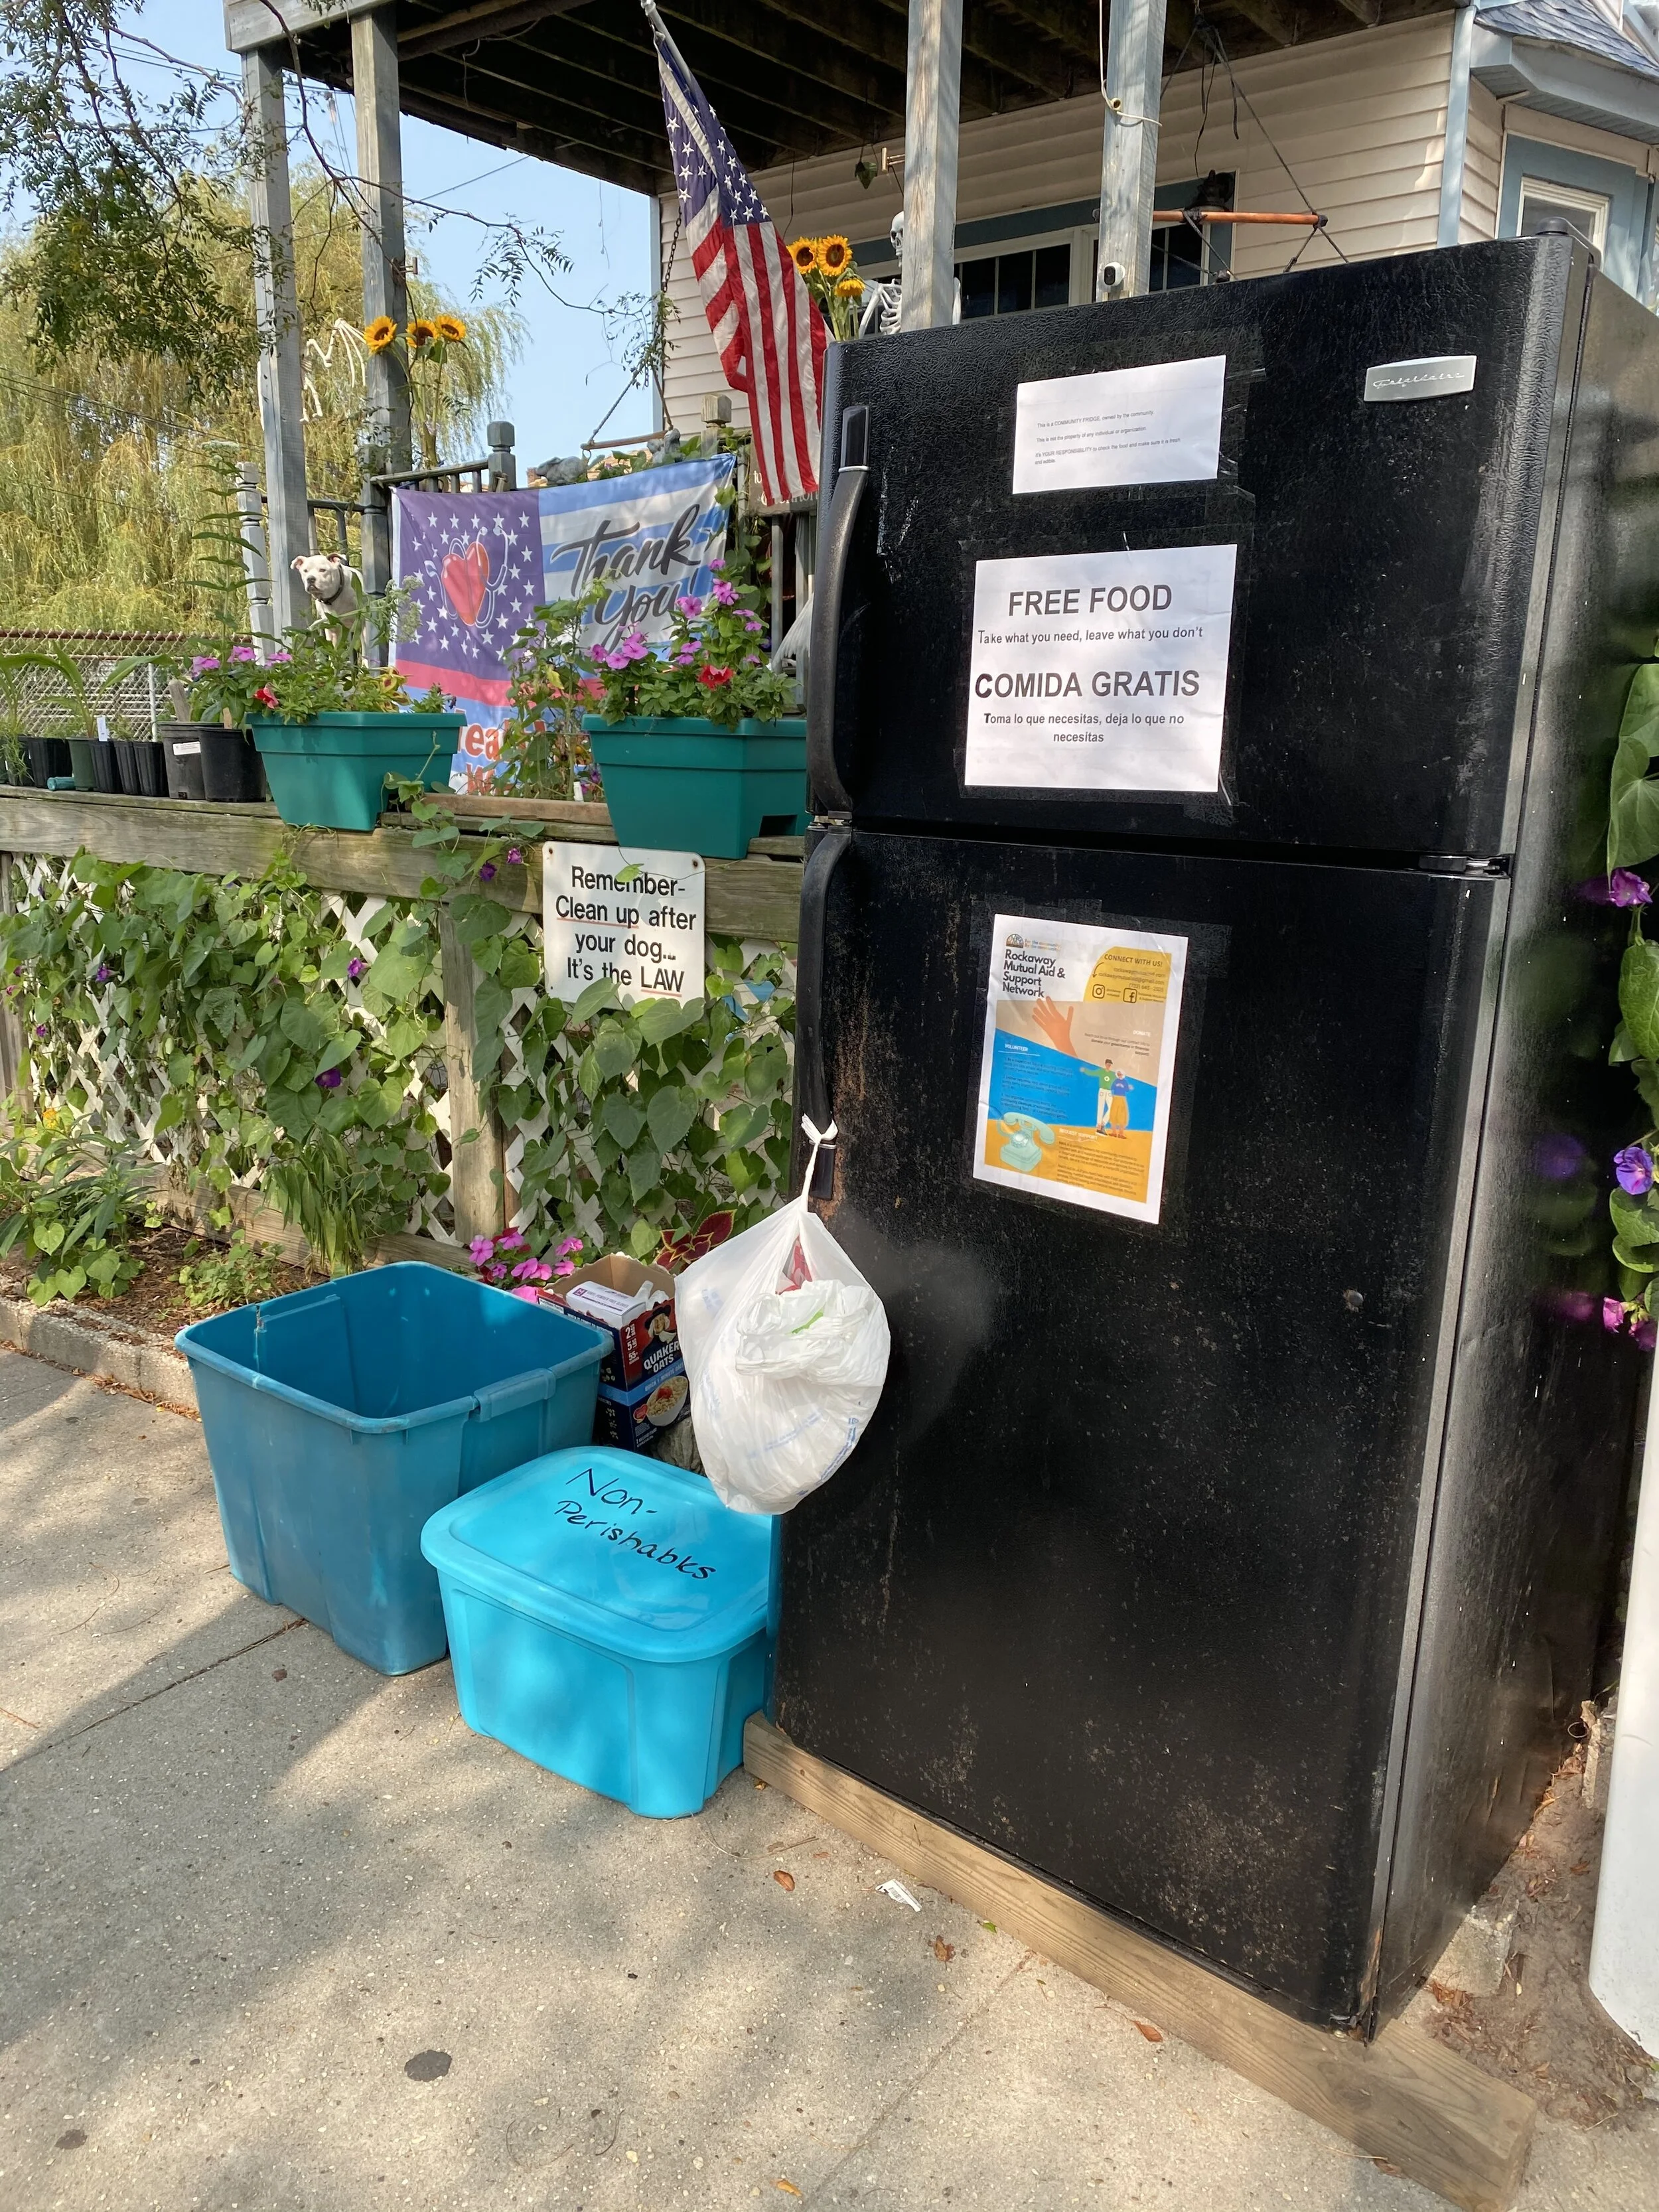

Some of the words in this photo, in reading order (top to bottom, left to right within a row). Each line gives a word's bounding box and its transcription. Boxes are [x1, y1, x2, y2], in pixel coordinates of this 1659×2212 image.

[1056, 447, 1092, 455] RESPONSIBILITY
[552, 504, 701, 597] Thank
[1009, 588, 1080, 617] FREE
[1090, 584, 1172, 613] FOOD
[978, 630, 1002, 644] Take
[1005, 631, 1029, 644] what
[1031, 632, 1050, 645] you
[1054, 630, 1082, 644] need,
[1086, 628, 1114, 640] leave
[1118, 628, 1145, 640] what
[1148, 629, 1169, 641] you
[975, 672, 1082, 699] COMIDA
[1092, 670, 1200, 697] GRATIS
[983, 713, 1011, 724] Toma
[1014, 713, 1023, 724] lo
[1026, 715, 1045, 726] que
[1048, 713, 1102, 726] necesitas,
[1106, 713, 1128, 726] deja
[1131, 713, 1141, 724] lo
[1145, 715, 1166, 726] que
[1169, 715, 1185, 724] no
[1053, 731, 1104, 743] necesitas
[556, 895, 607, 921] Clean
[616, 907, 639, 928] up
[648, 906, 696, 930] after
[575, 933, 616, 954] your
[624, 934, 676, 963] dog...
[1005, 949, 1056, 968] Rockaway
[1104, 954, 1134, 964] CONNECT
[567, 957, 593, 980] It's
[602, 962, 632, 986] the
[641, 966, 684, 992] LAW
[1003, 960, 1037, 974] Mutual
[1038, 965, 1055, 977] Aid
[1056, 968, 1066, 979] &
[1003, 971, 1042, 986] Support
[1003, 982, 1045, 997] Network
[643, 1341, 681, 1370] QUAKER
[653, 1354, 674, 1373] OATS
[565, 1468, 658, 1514] Non-
